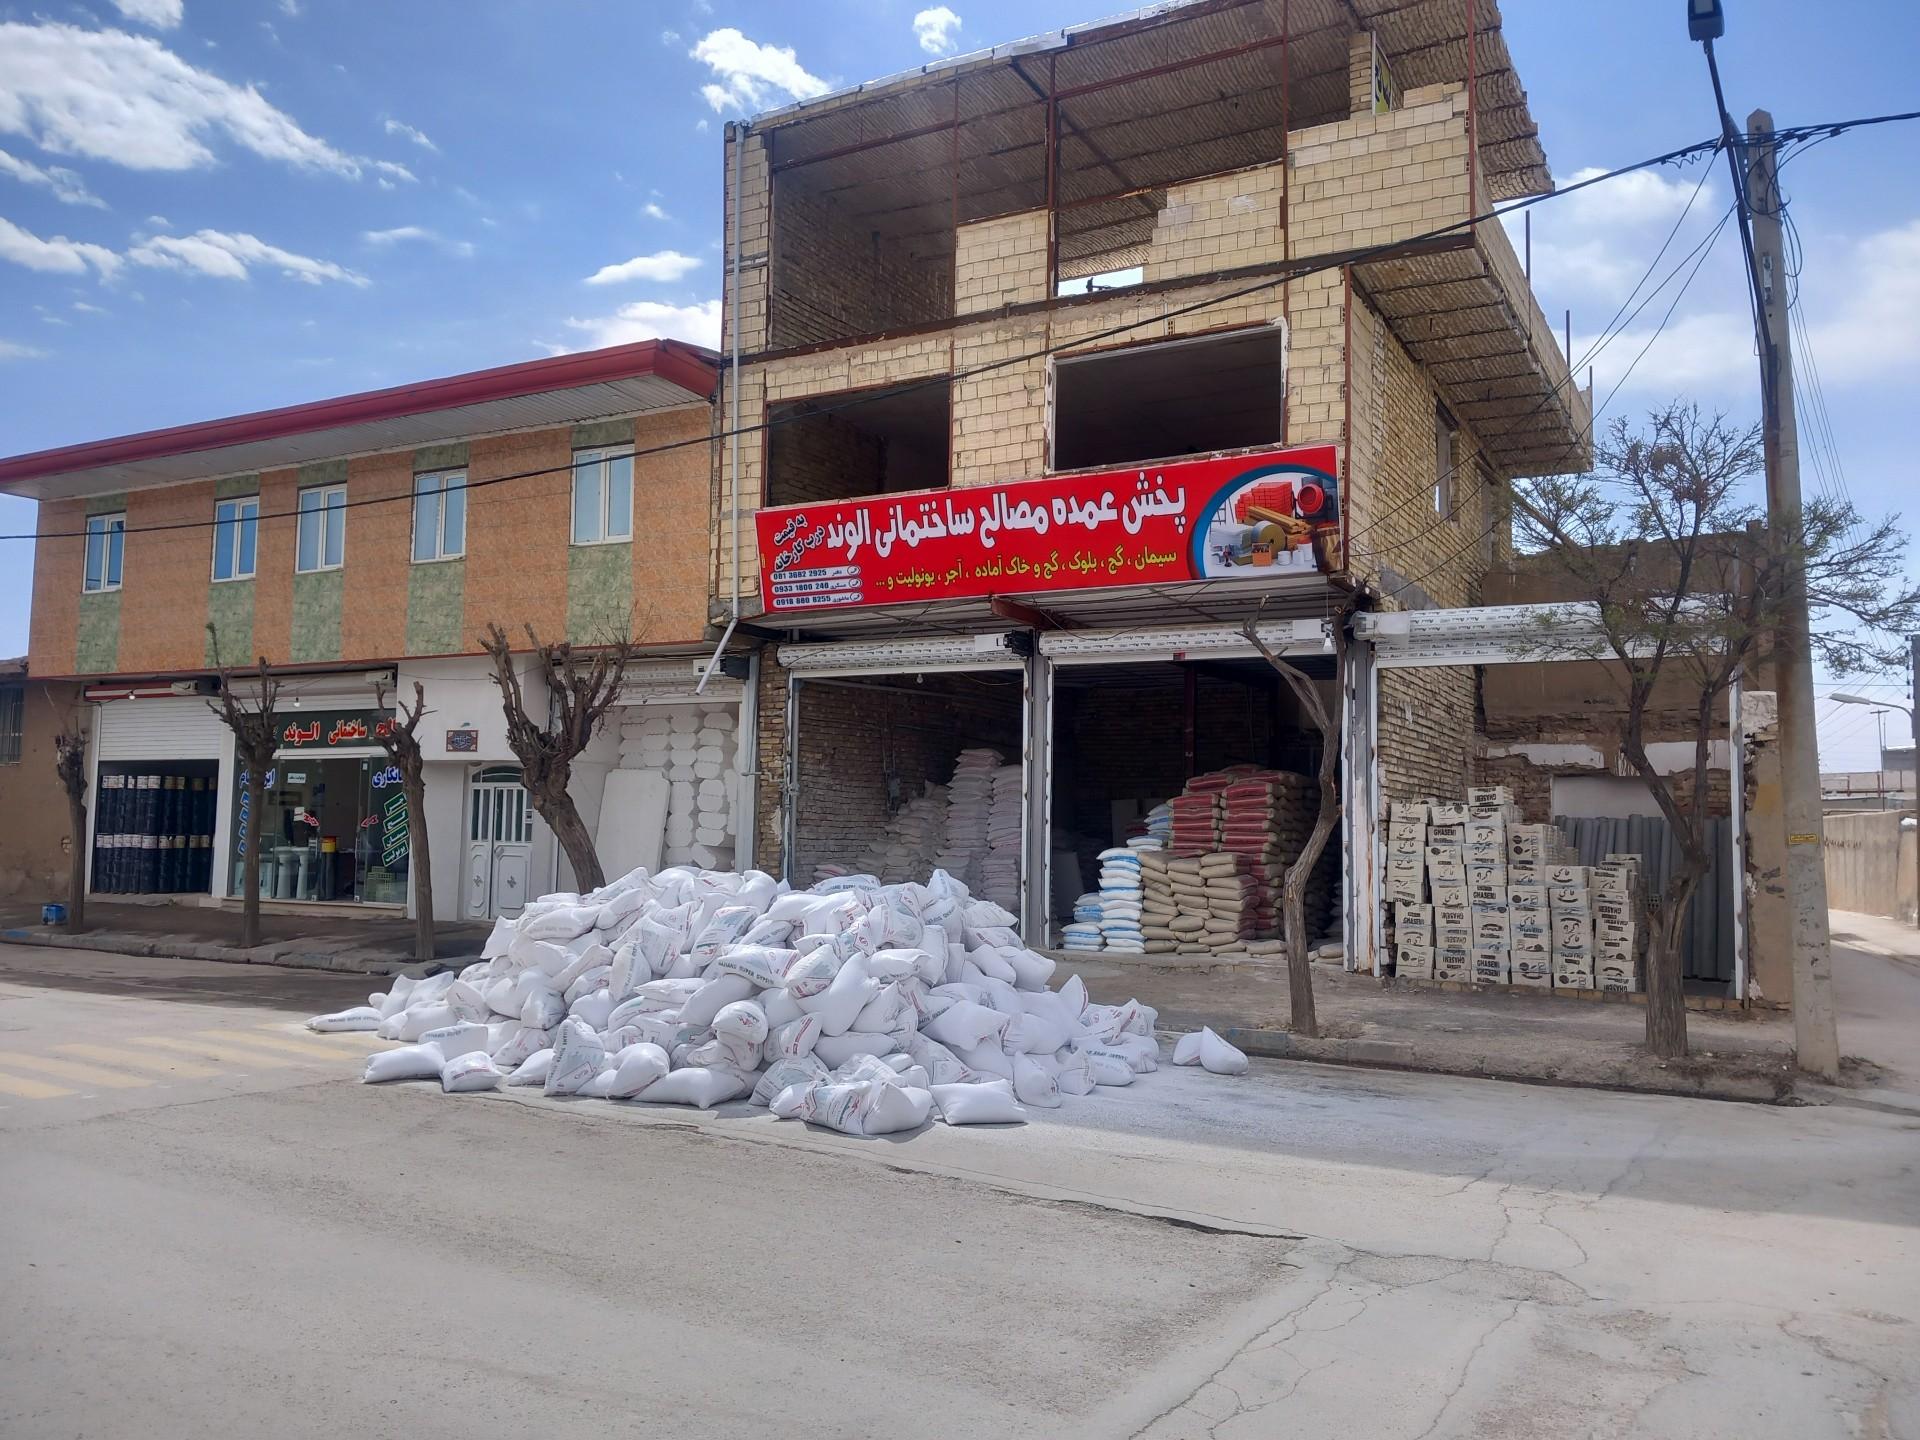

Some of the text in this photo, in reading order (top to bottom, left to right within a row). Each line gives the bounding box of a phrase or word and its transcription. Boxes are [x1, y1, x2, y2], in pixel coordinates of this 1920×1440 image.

[827, 471, 1186, 561] پخش عمده مصالح ساختمانی الوند
[774, 514, 808, 545] به قیمت
[775, 526, 825, 571] درب کارخانه
[1108, 544, 1124, 575] گچ
[1134, 546, 1177, 570] سیمان
[944, 558, 962, 585] آجر
[975, 555, 1002, 578] آماده
[1005, 556, 1031, 575] خاک
[1033, 563, 1041, 576] و
[1043, 550, 1059, 580] گچ
[1069, 551, 1097, 574] بلوک
[896, 567, 934, 587] یونولیت
[283, 721, 320, 746] الوند
[327, 719, 367, 745] ساختمانی
[1473, 891, 1496, 900] GHASEMI
